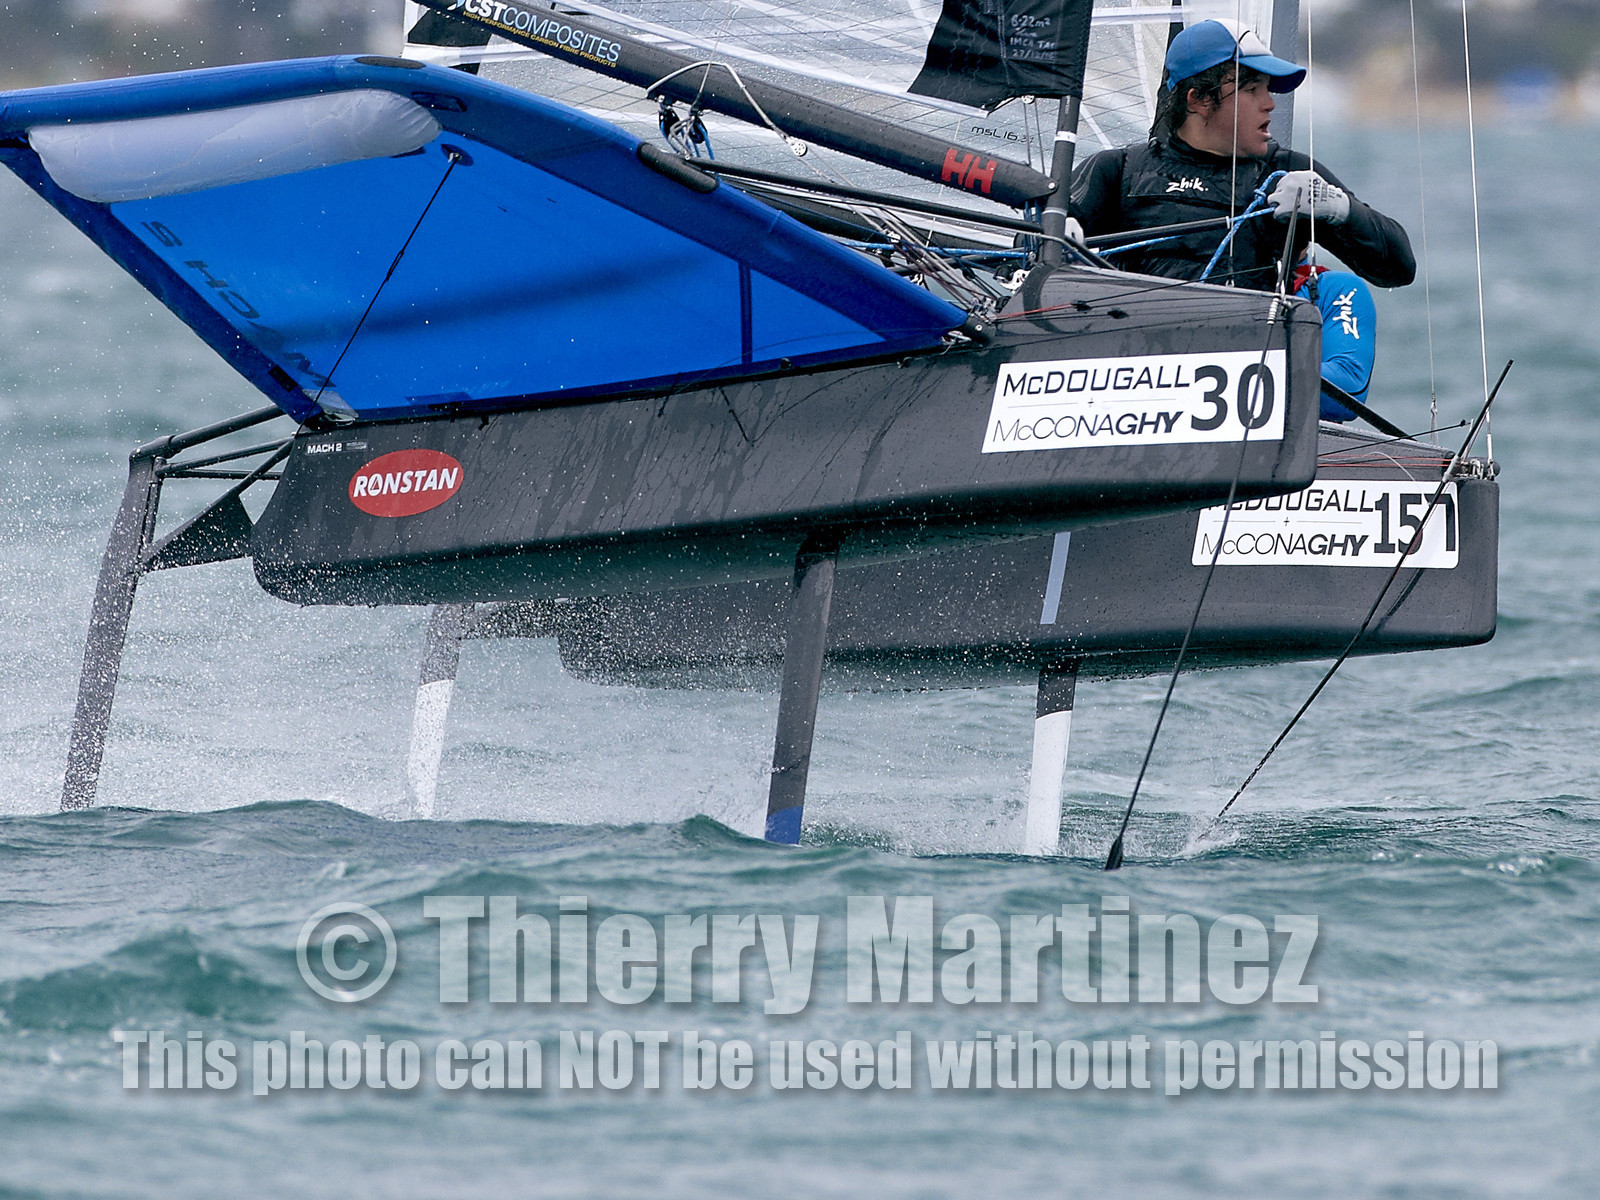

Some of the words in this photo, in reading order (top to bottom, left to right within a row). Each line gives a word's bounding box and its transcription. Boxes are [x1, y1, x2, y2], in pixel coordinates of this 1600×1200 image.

[481, 17, 530, 38] PERFORMANCE
[530, 34, 559, 48] CARBON
[580, 51, 617, 68] PRODUCTS
[940, 148, 997, 194] HH
[1003, 365, 1190, 397] McDOUGALL
[1190, 363, 1275, 431] 30
[993, 411, 1184, 442] McCONAGHY
[307, 443, 335, 454] MACH
[335, 442, 342, 452] 2
[353, 467, 459, 497] RONSTAN
[1374, 492, 1456, 555] 157
[1200, 533, 1369, 556] McCONAGHY
